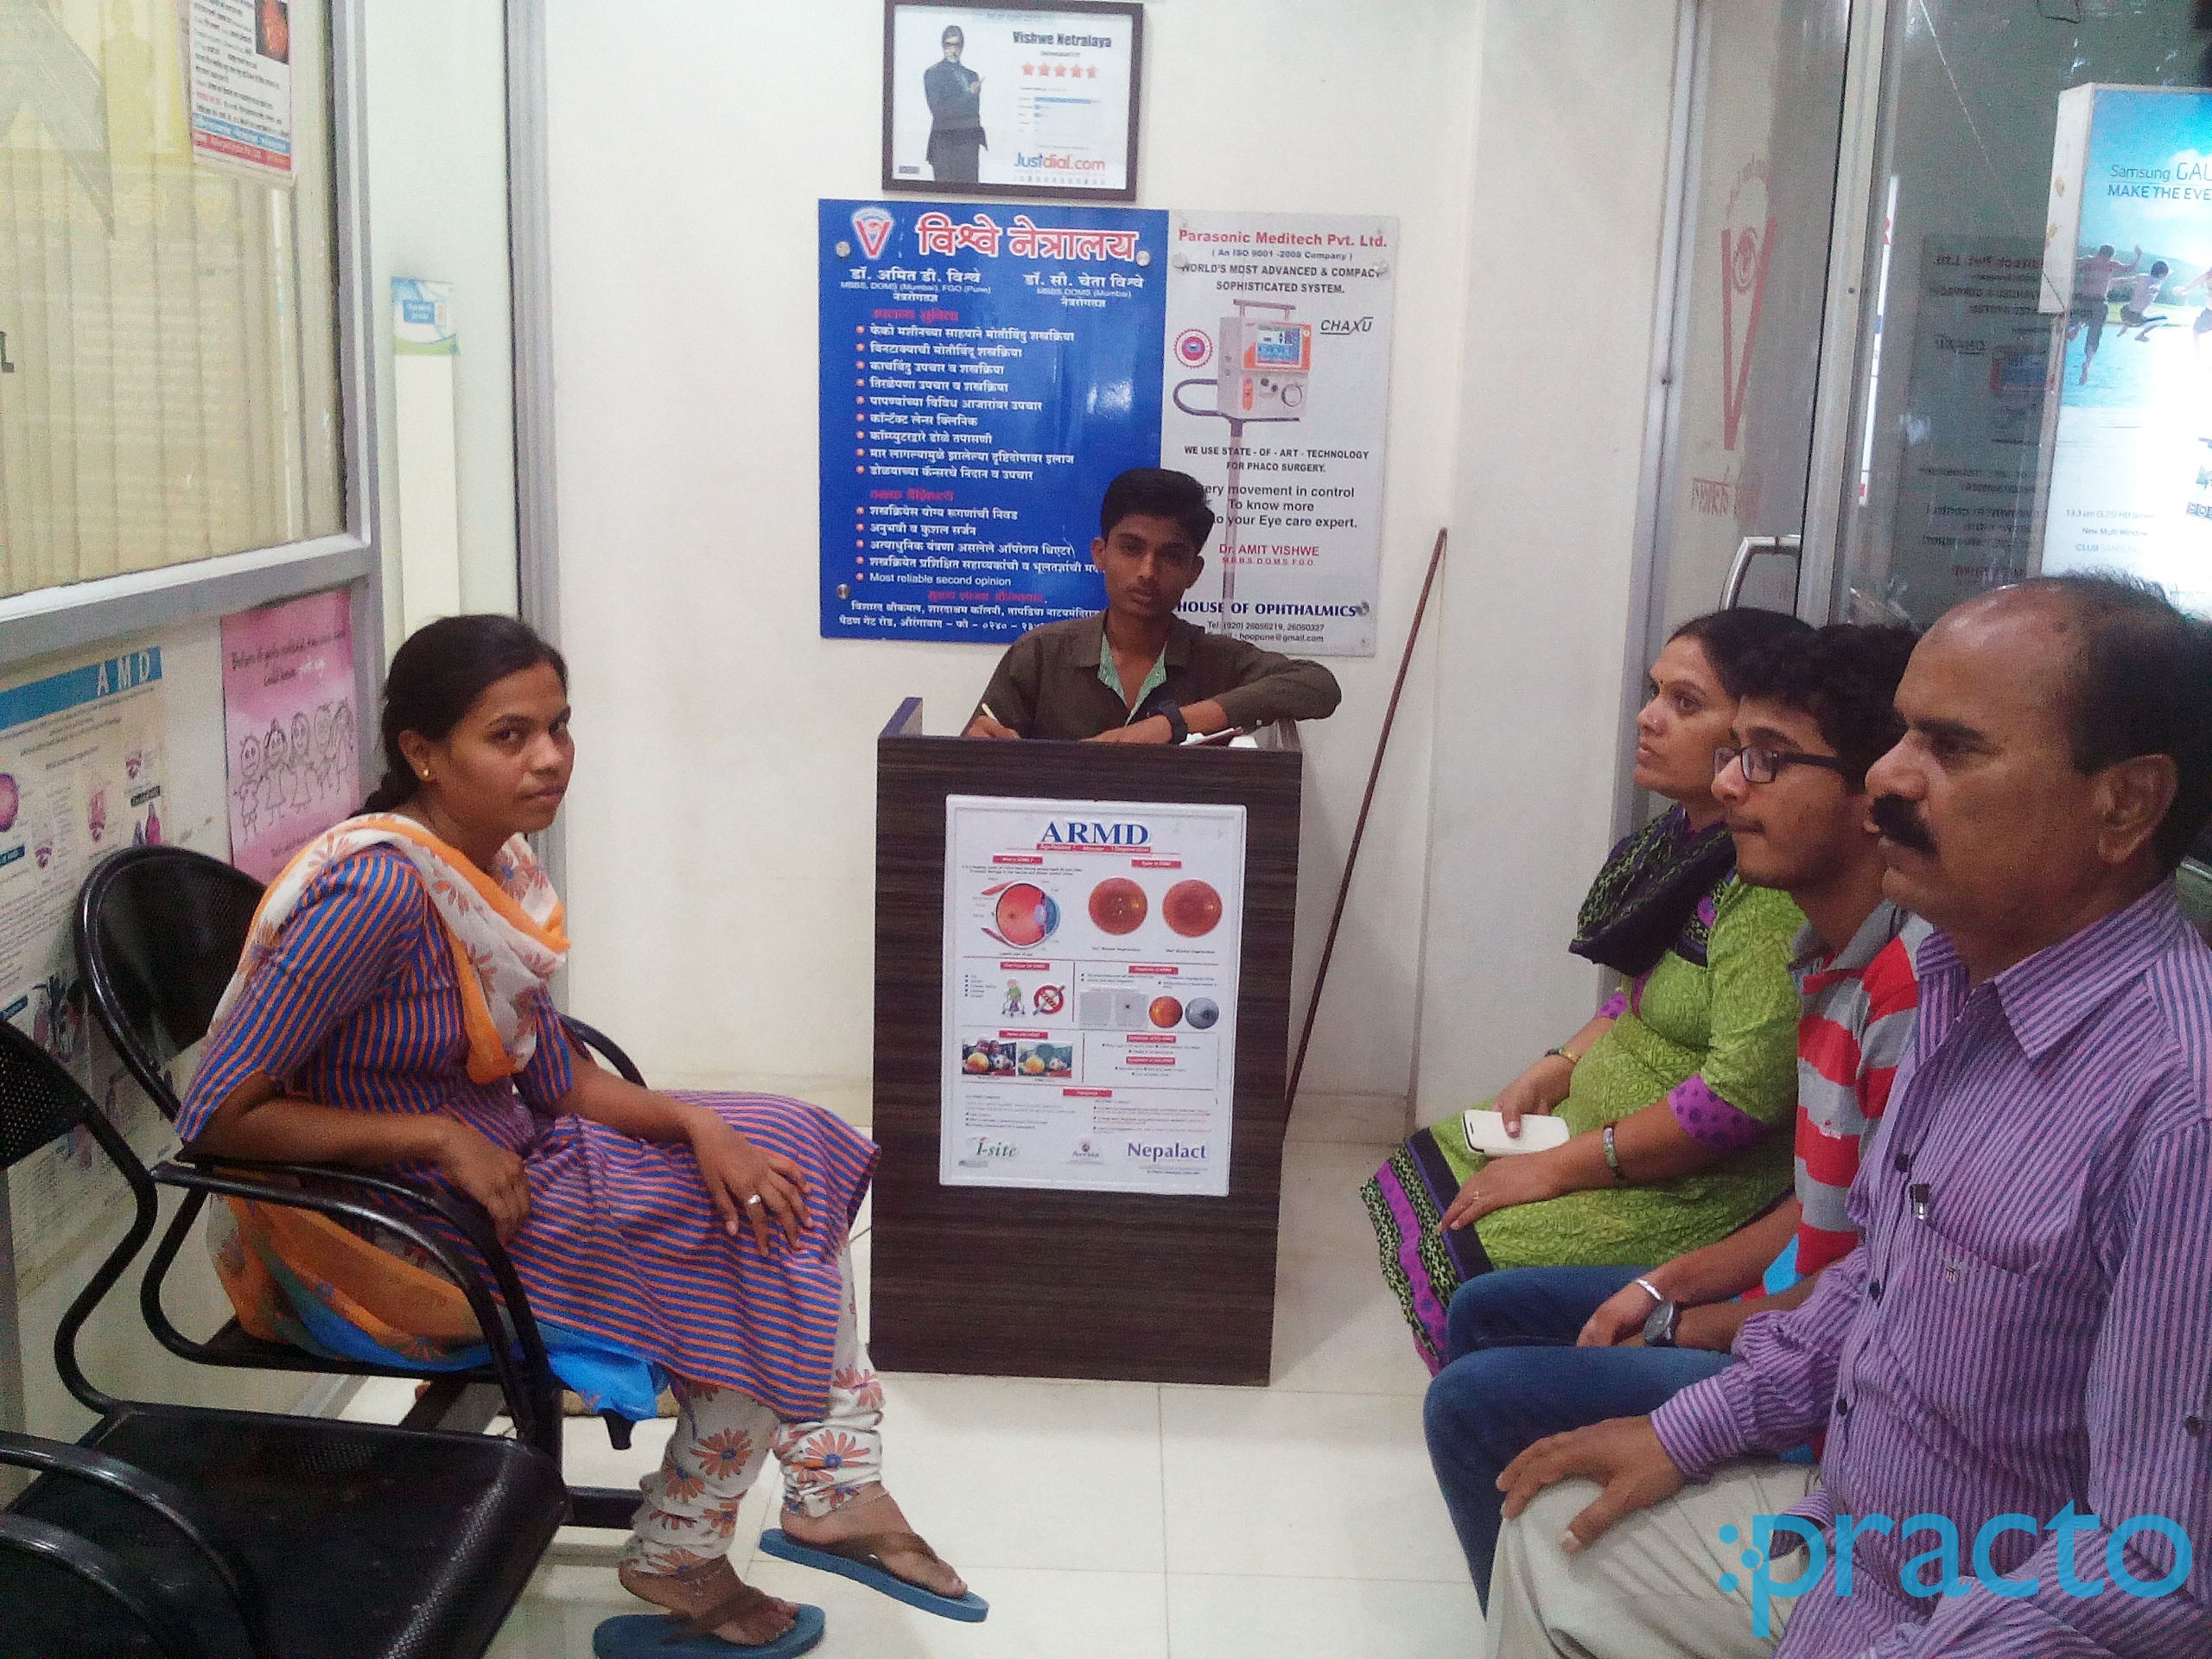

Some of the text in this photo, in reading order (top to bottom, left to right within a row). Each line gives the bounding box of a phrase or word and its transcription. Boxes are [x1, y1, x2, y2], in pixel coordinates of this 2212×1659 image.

[1013, 31, 1112, 48] Vishwe Netralaya
[2111, 163, 2171, 182] Samsung
[2107, 184, 2150, 199] MAKE
[2152, 185, 2180, 200] THE
[915, 212, 1140, 262] विश्वे नेत्रालय
[1179, 228, 1388, 247] Parasonic Meditech Pvt. Ltd.
[1304, 251, 1347, 261] Company
[849, 266, 982, 283] डॉ. अमित डी. विश्वे
[1230, 264, 1258, 275] MOST
[1261, 264, 1317, 276] ADVANCED
[1320, 267, 1328, 276] &
[1022, 271, 1045, 286] डॉ.
[1109, 272, 1144, 289] विश्वे
[1216, 280, 1345, 294] SOPHISTICATED SYSTEM.
[913, 363, 946, 372] उपचार
[917, 380, 950, 391] उपचार
[926, 395, 958, 408] विविध
[1010, 401, 1044, 412] उपचार
[1184, 445, 1370, 460] WE USE STATE OF ART TECHNOLOGY
[1226, 461, 1326, 473] FOR PHACO SURGERY.
[1001, 470, 1034, 480] उपचार
[1228, 486, 1355, 497] movement in control
[1229, 499, 1315, 512] To know more
[1227, 515, 1357, 530] your Eye care expert.
[2082, 526, 2098, 535] New
[1238, 543, 1268, 555] AMIT
[1271, 544, 1320, 556] VISHWE
[2075, 543, 2100, 552] CLUB
[869, 572, 1012, 588] Most reliable second opinion
[1177, 600, 1357, 617] HOUSE OF OPHTHALMICS
[1040, 821, 1149, 846] ARMD
[1127, 1141, 1207, 1162] Nepalact
